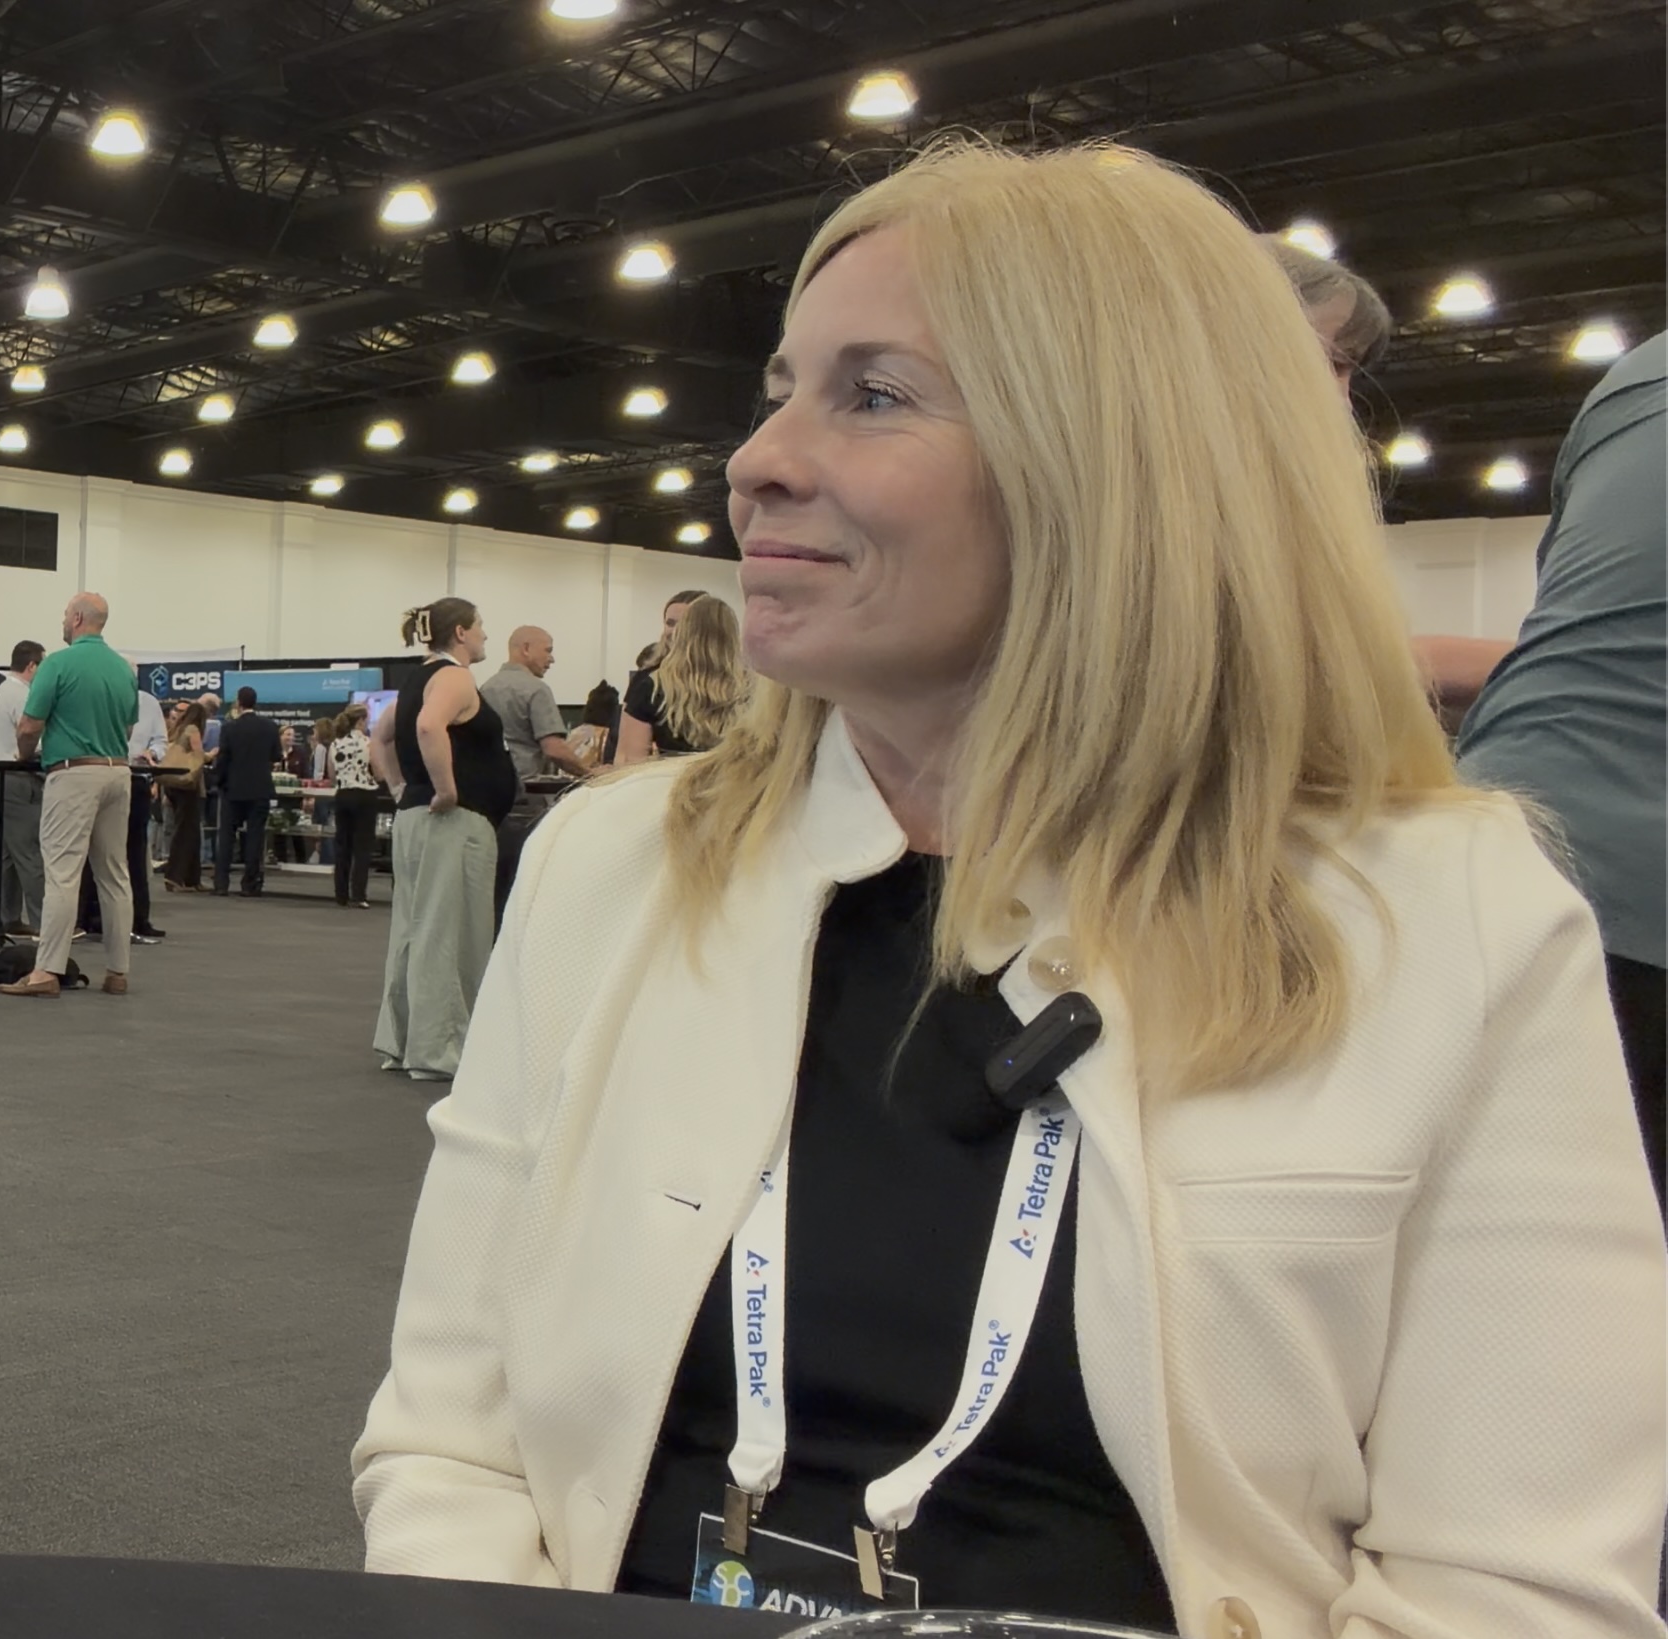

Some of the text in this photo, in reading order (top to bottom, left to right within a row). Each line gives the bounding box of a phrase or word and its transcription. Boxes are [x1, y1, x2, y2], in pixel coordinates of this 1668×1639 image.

[172, 671, 221, 690] C3PS
[1017, 1163, 1054, 1220] Tetra
[746, 1284, 767, 1345] Tetra
[952, 1382, 995, 1435] Tetra
